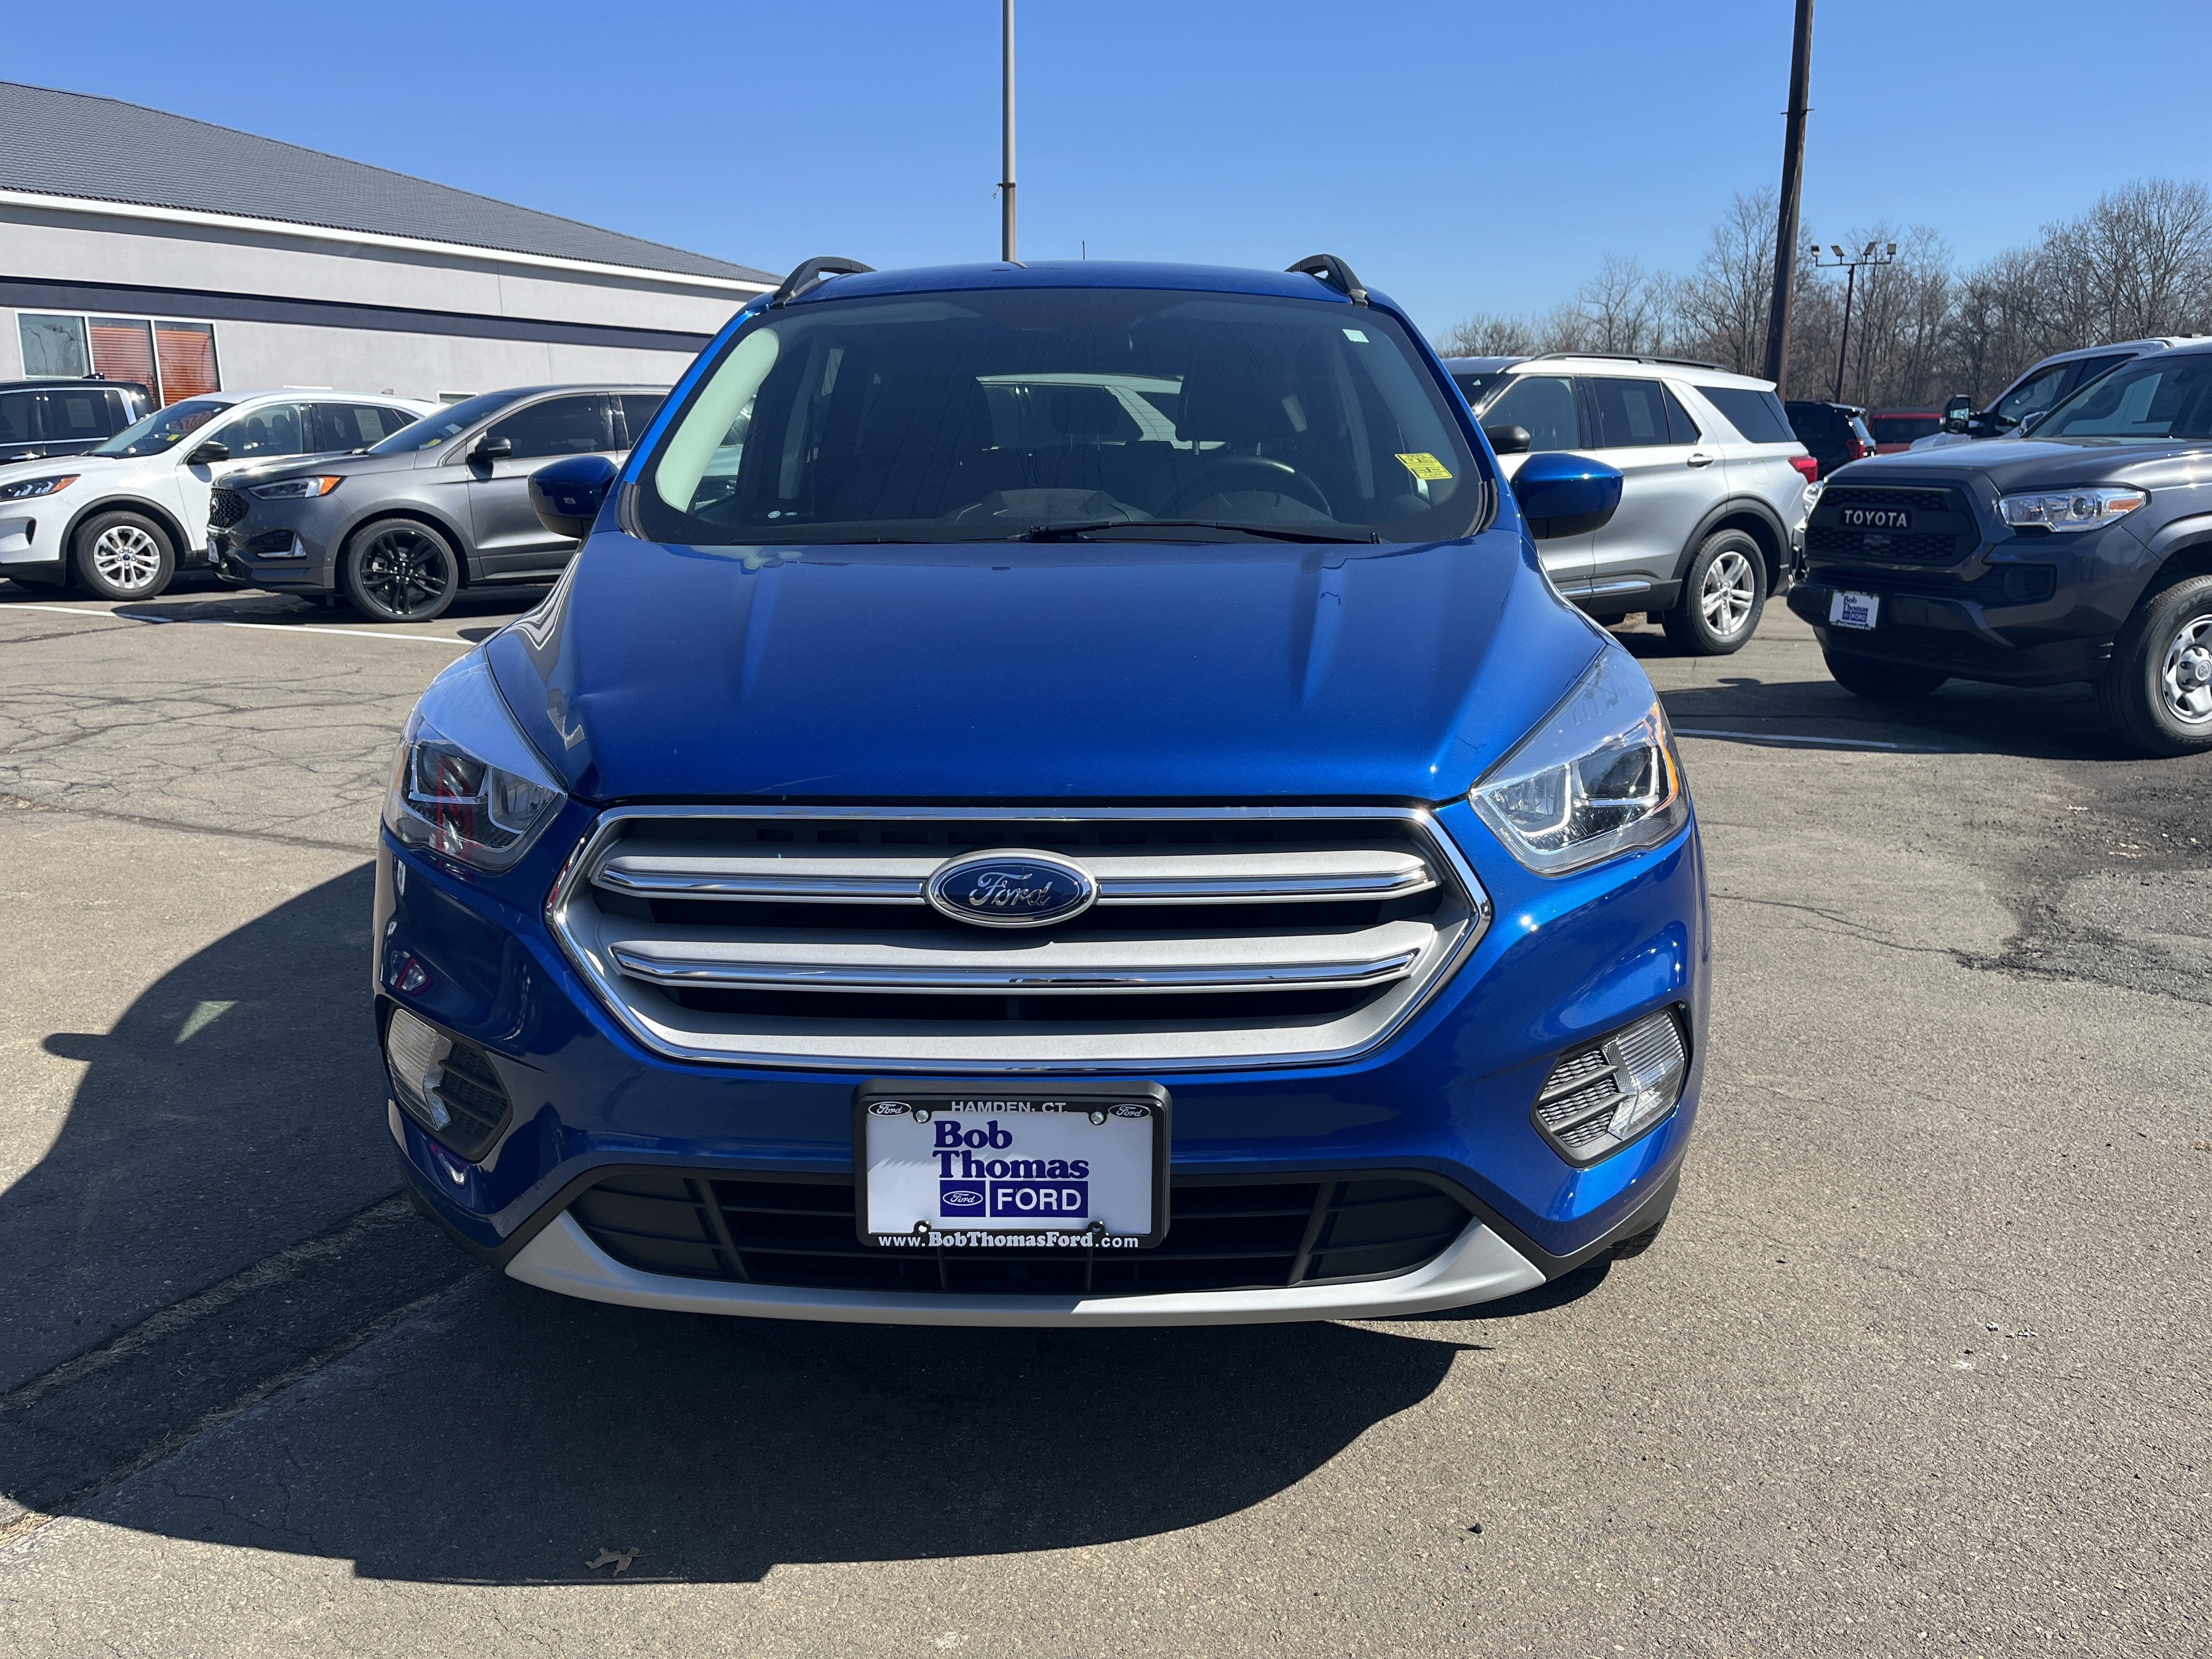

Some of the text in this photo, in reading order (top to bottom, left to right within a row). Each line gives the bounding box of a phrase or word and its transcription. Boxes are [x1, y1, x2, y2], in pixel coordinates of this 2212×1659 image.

[1844, 509, 1908, 528] TOYOTA
[1844, 595, 1857, 604] Bob
[1843, 604, 1869, 612] Thomas
[968, 871, 1053, 906] Ford
[876, 1103, 903, 1114] Ford
[951, 1101, 1068, 1114] HAMDEN, CT.
[1116, 1105, 1142, 1117] Ford
[934, 1120, 1013, 1149] Bob
[933, 1150, 1090, 1179] Thomas
[950, 1193, 975, 1203] Ford
[997, 1188, 1081, 1210] FORD
[878, 1231, 1139, 1248] www.BobThomasFord.com
